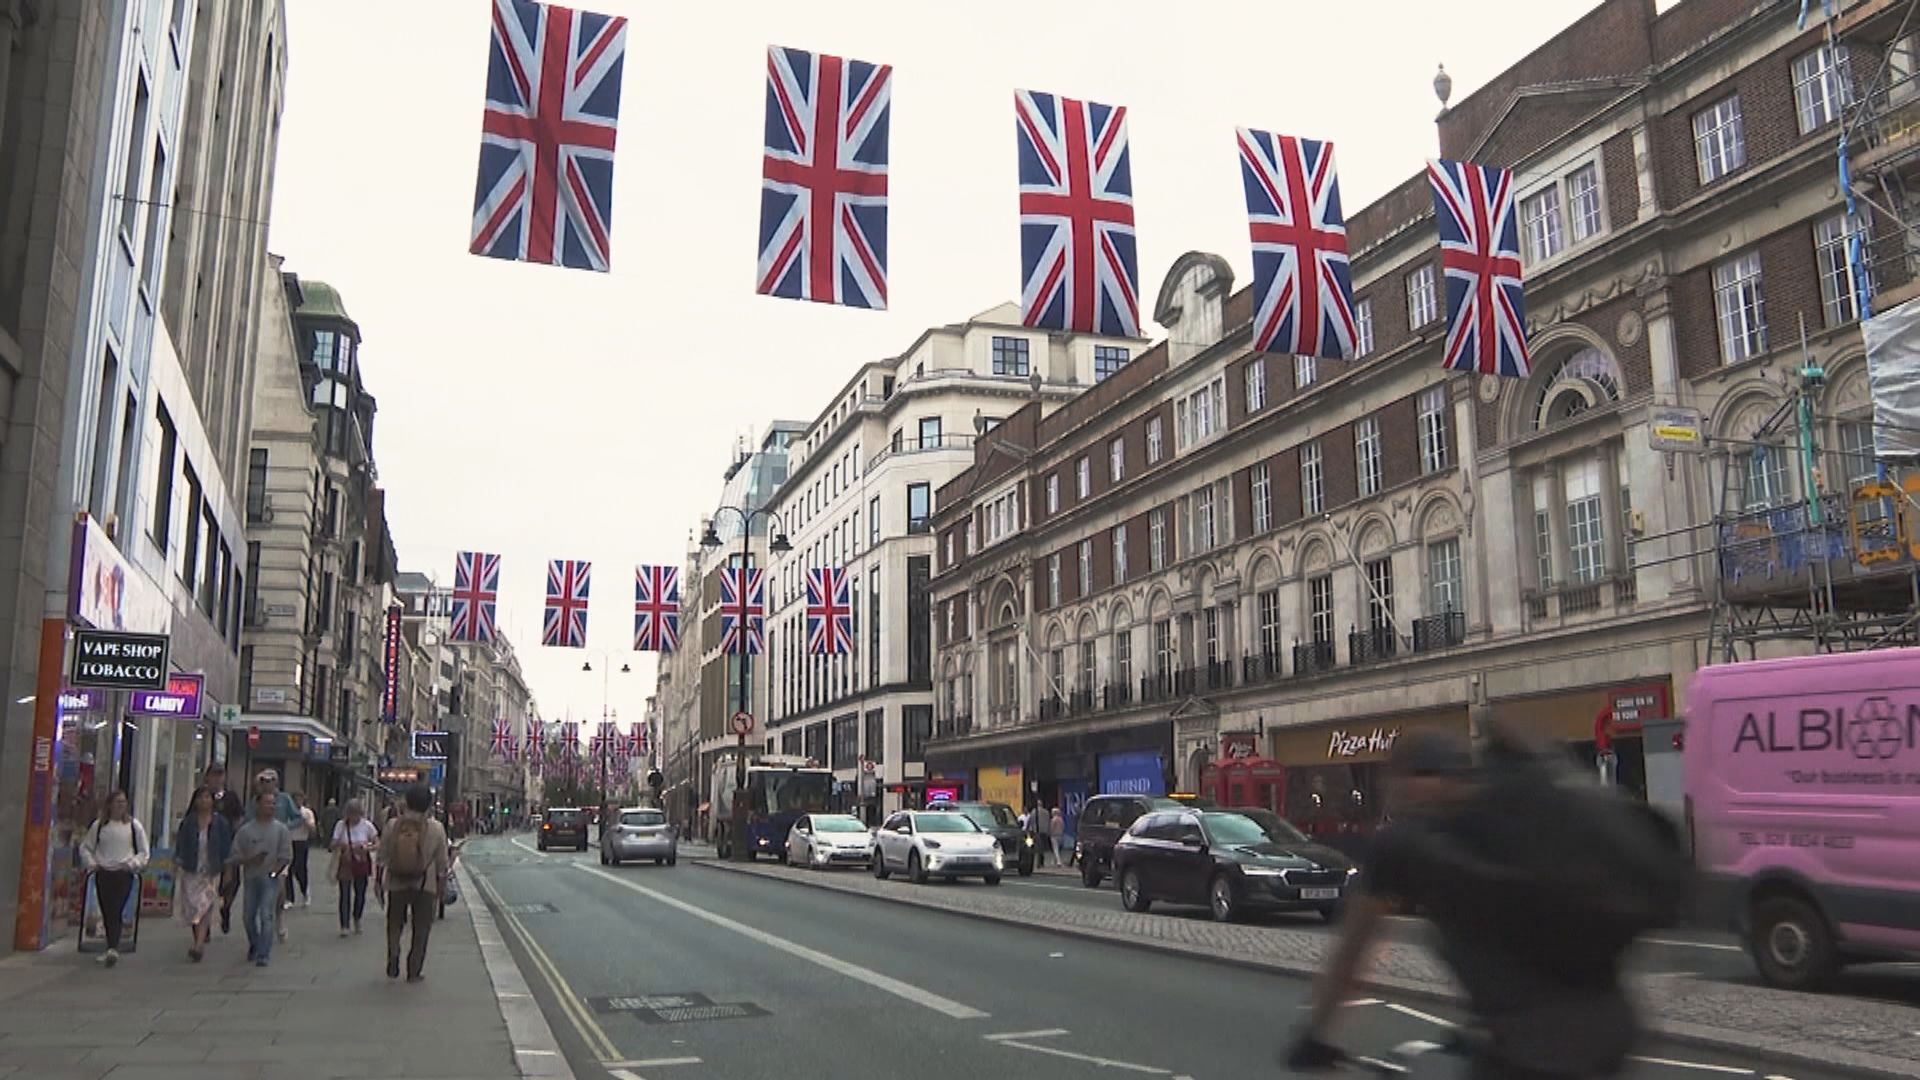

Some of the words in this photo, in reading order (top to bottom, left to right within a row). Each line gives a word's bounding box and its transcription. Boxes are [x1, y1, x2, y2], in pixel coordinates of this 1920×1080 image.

[83, 642, 120, 656] VAPE
[122, 643, 162, 658] SHOP
[81, 662, 159, 680] TOBACCO
[145, 695, 185, 713] CANDY
[420, 739, 444, 753] SIX
[1328, 730, 1367, 758] Pizza
[1368, 727, 1396, 753] Hut
[34, 736, 51, 771] CANDY
